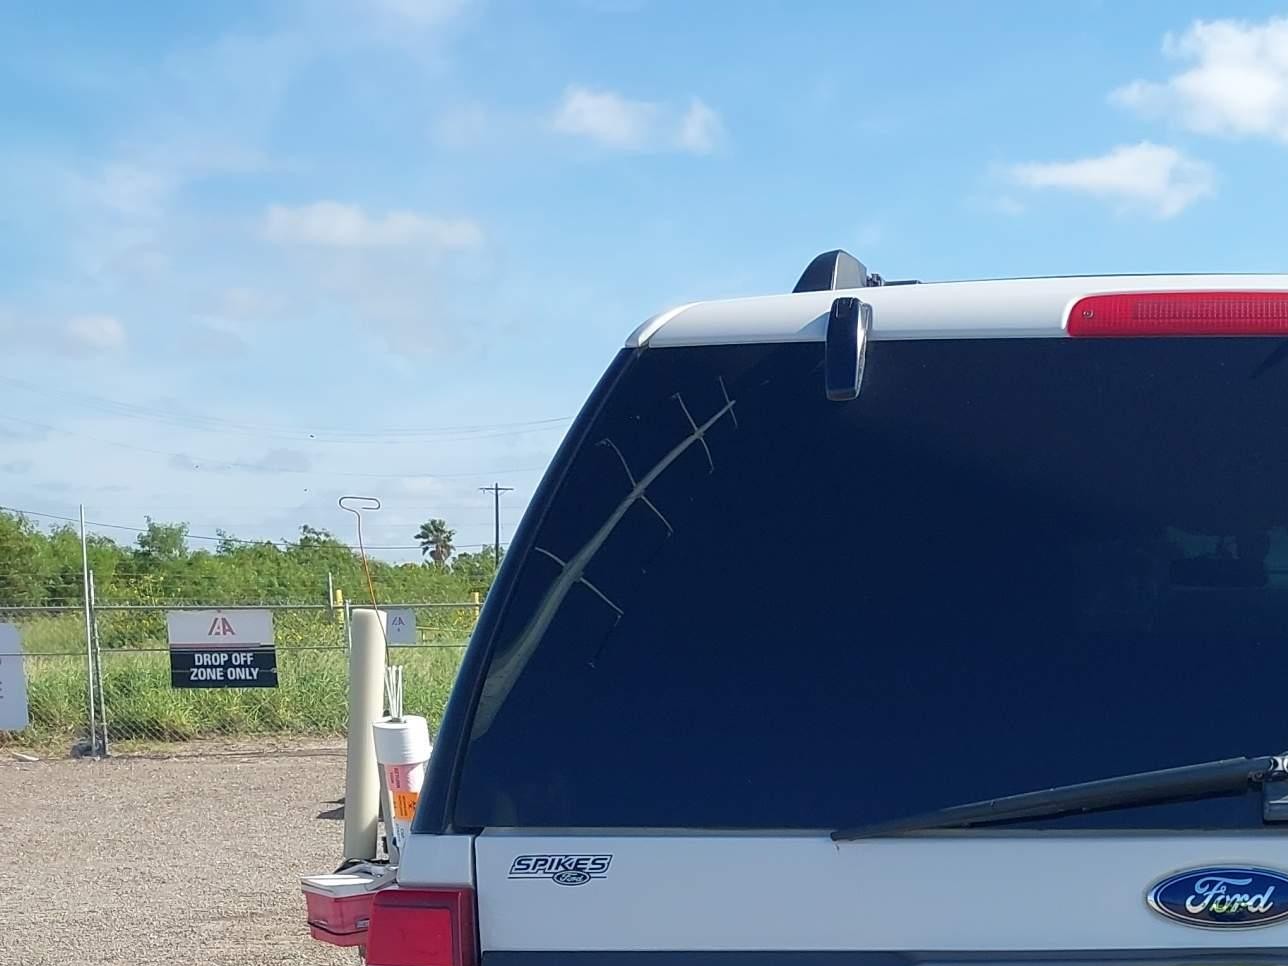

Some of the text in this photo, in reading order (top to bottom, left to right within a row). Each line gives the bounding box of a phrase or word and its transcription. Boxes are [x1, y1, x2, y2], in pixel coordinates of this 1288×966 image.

[194, 652, 254, 666] DROP OFF
[190, 667, 259, 680] ZONE ONLY
[513, 857, 609, 871] SPIKES
[559, 872, 584, 882] Ford
[1185, 876, 1276, 914] Ford
